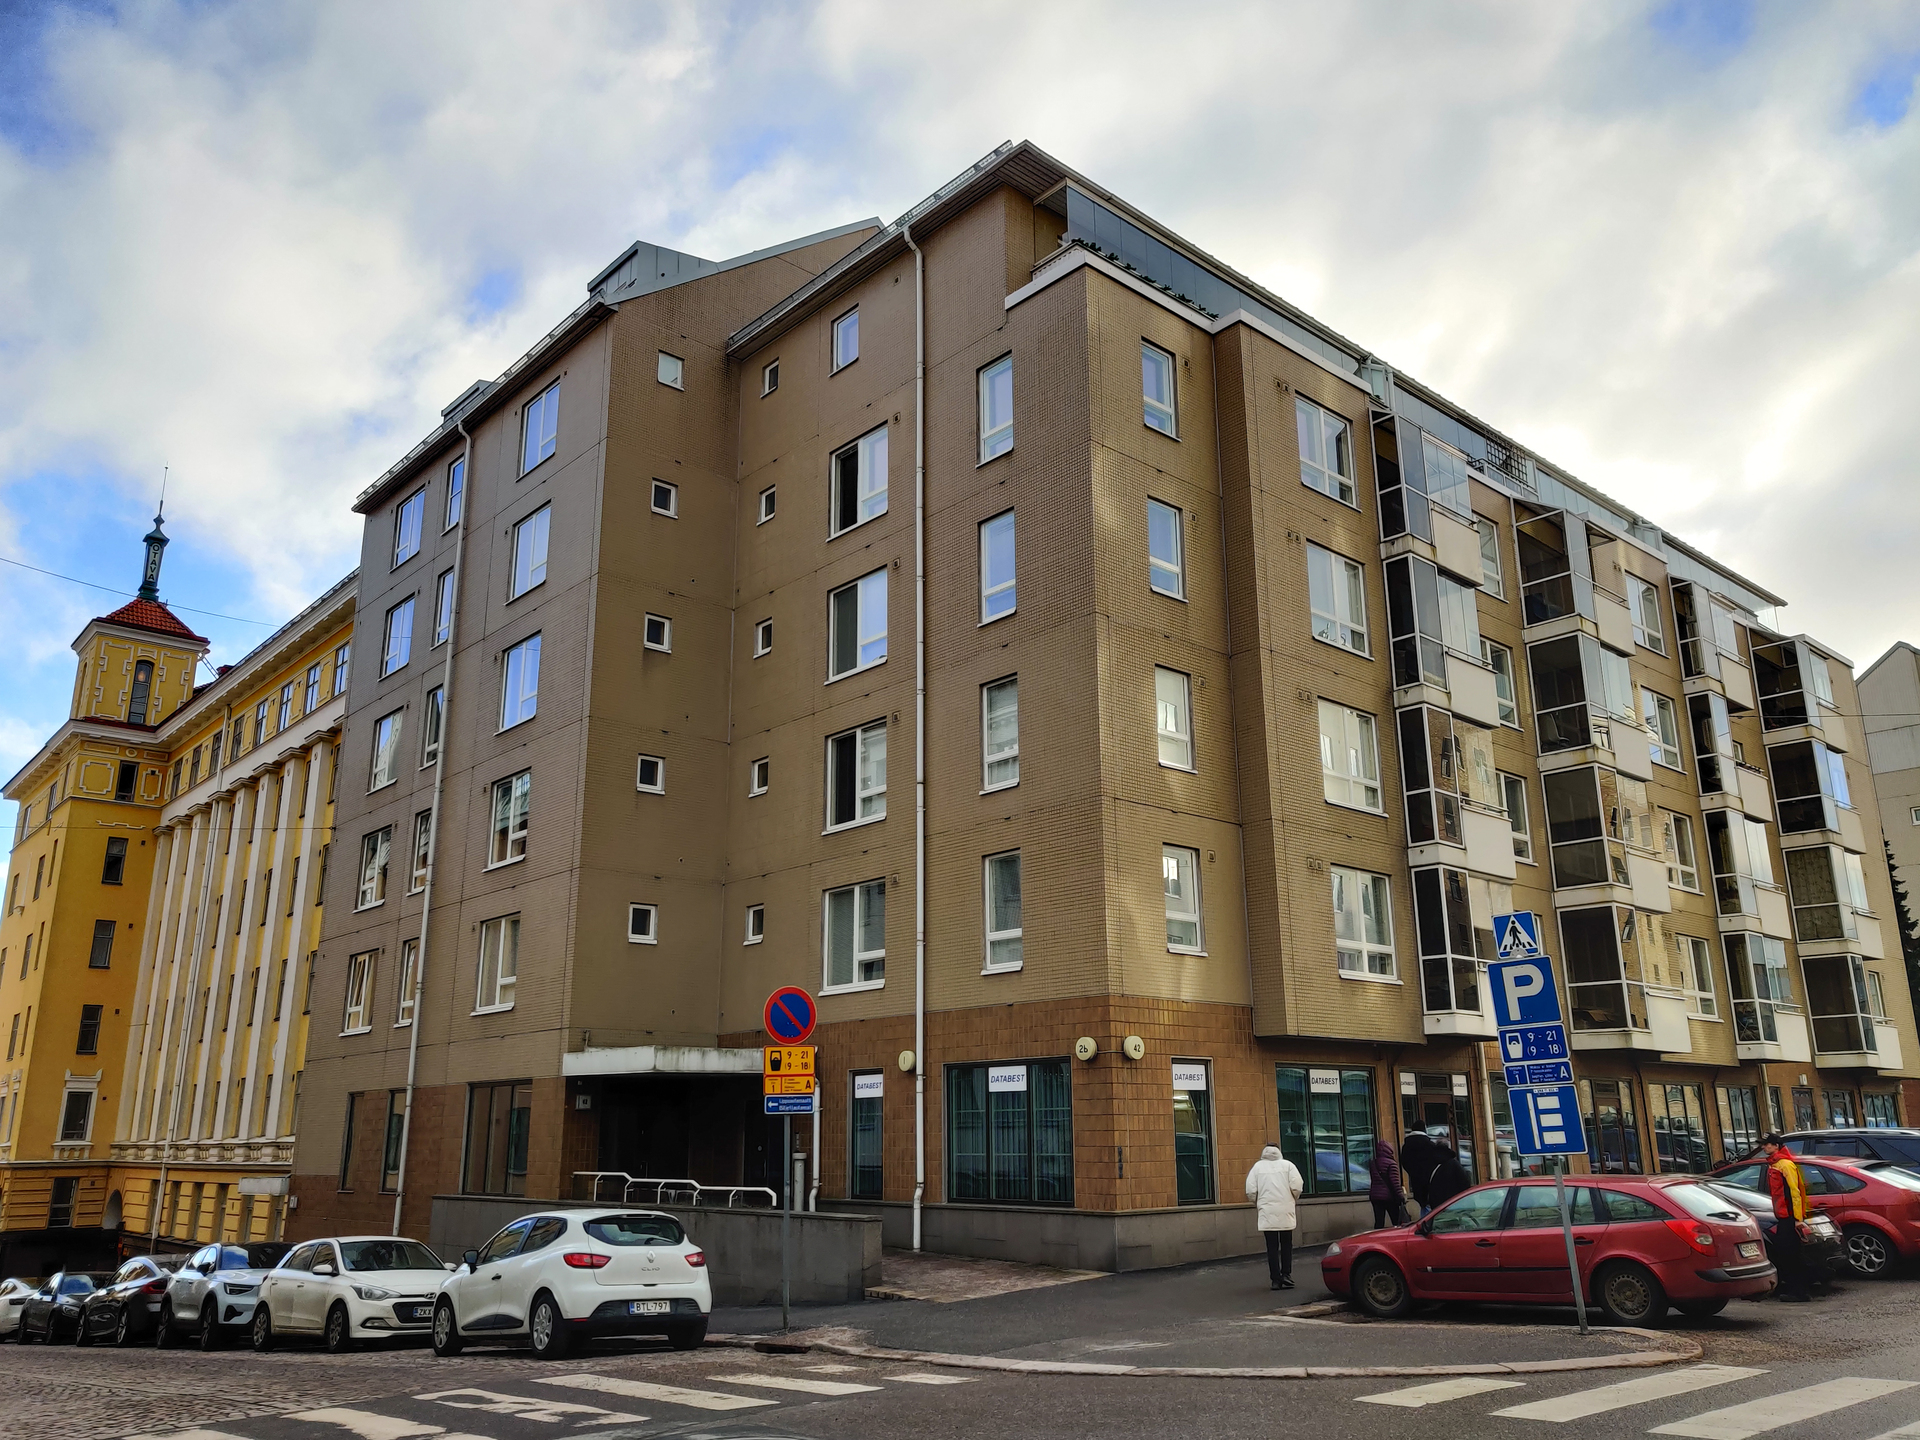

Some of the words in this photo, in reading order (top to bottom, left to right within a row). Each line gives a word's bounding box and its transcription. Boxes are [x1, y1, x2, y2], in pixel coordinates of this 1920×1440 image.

[147, 544, 160, 581] OTAVA
[1501, 963, 1545, 1021] P
[1527, 1032, 1535, 1042] 9
[1546, 1030, 1557, 1041] 21
[1133, 1044, 1141, 1053] 42
[1527, 1045, 1537, 1056] (9
[1548, 1043, 1563, 1055] 18)
[787, 1051, 792, 1059] 9
[801, 1051, 809, 1059] 21
[1560, 1065, 1569, 1078] A
[990, 1074, 1026, 1083] DATABEST
[1174, 1073, 1204, 1081] DATABEST
[1311, 1077, 1339, 1085] DATABEST
[1515, 1074, 1520, 1084] 1
[805, 1079, 812, 1090] A
[856, 1081, 882, 1090] DATABEST
[636, 1301, 668, 1312] BTL-797
